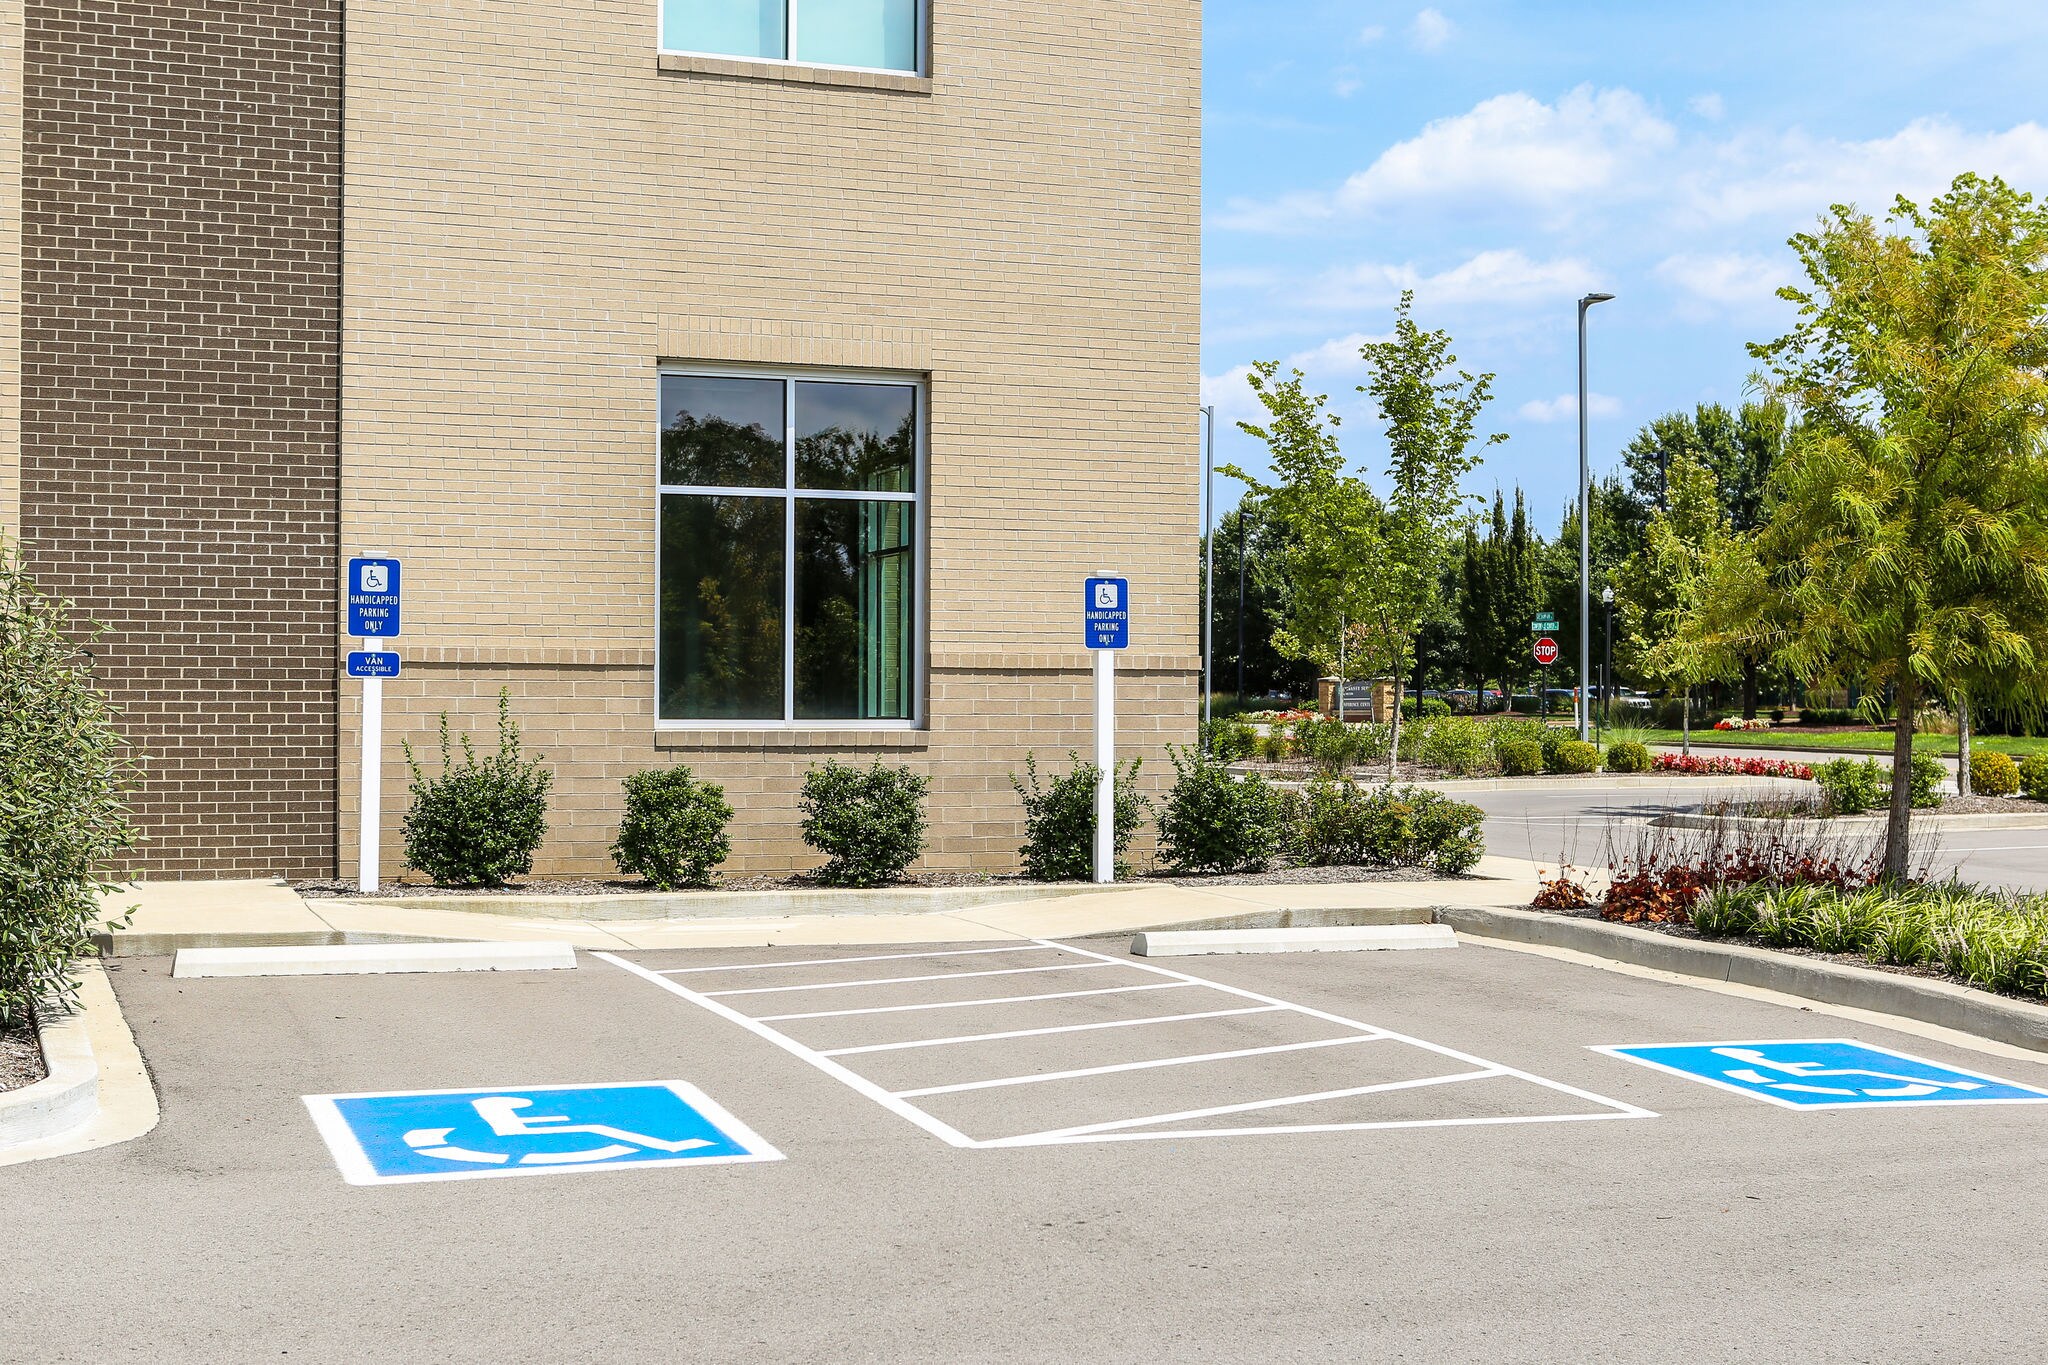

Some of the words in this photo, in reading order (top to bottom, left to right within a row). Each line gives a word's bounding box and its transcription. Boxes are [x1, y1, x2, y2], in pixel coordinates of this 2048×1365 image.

[350, 595, 398, 605] HANDICAPPED
[359, 608, 389, 617] PARKING
[1087, 611, 1126, 619] HANDICAPPED
[364, 621, 383, 630] ONLY
[1094, 623, 1119, 631] PARKING
[1099, 634, 1114, 642] ONLY
[1535, 645, 1556, 655] STOP
[365, 657, 383, 665] VAN
